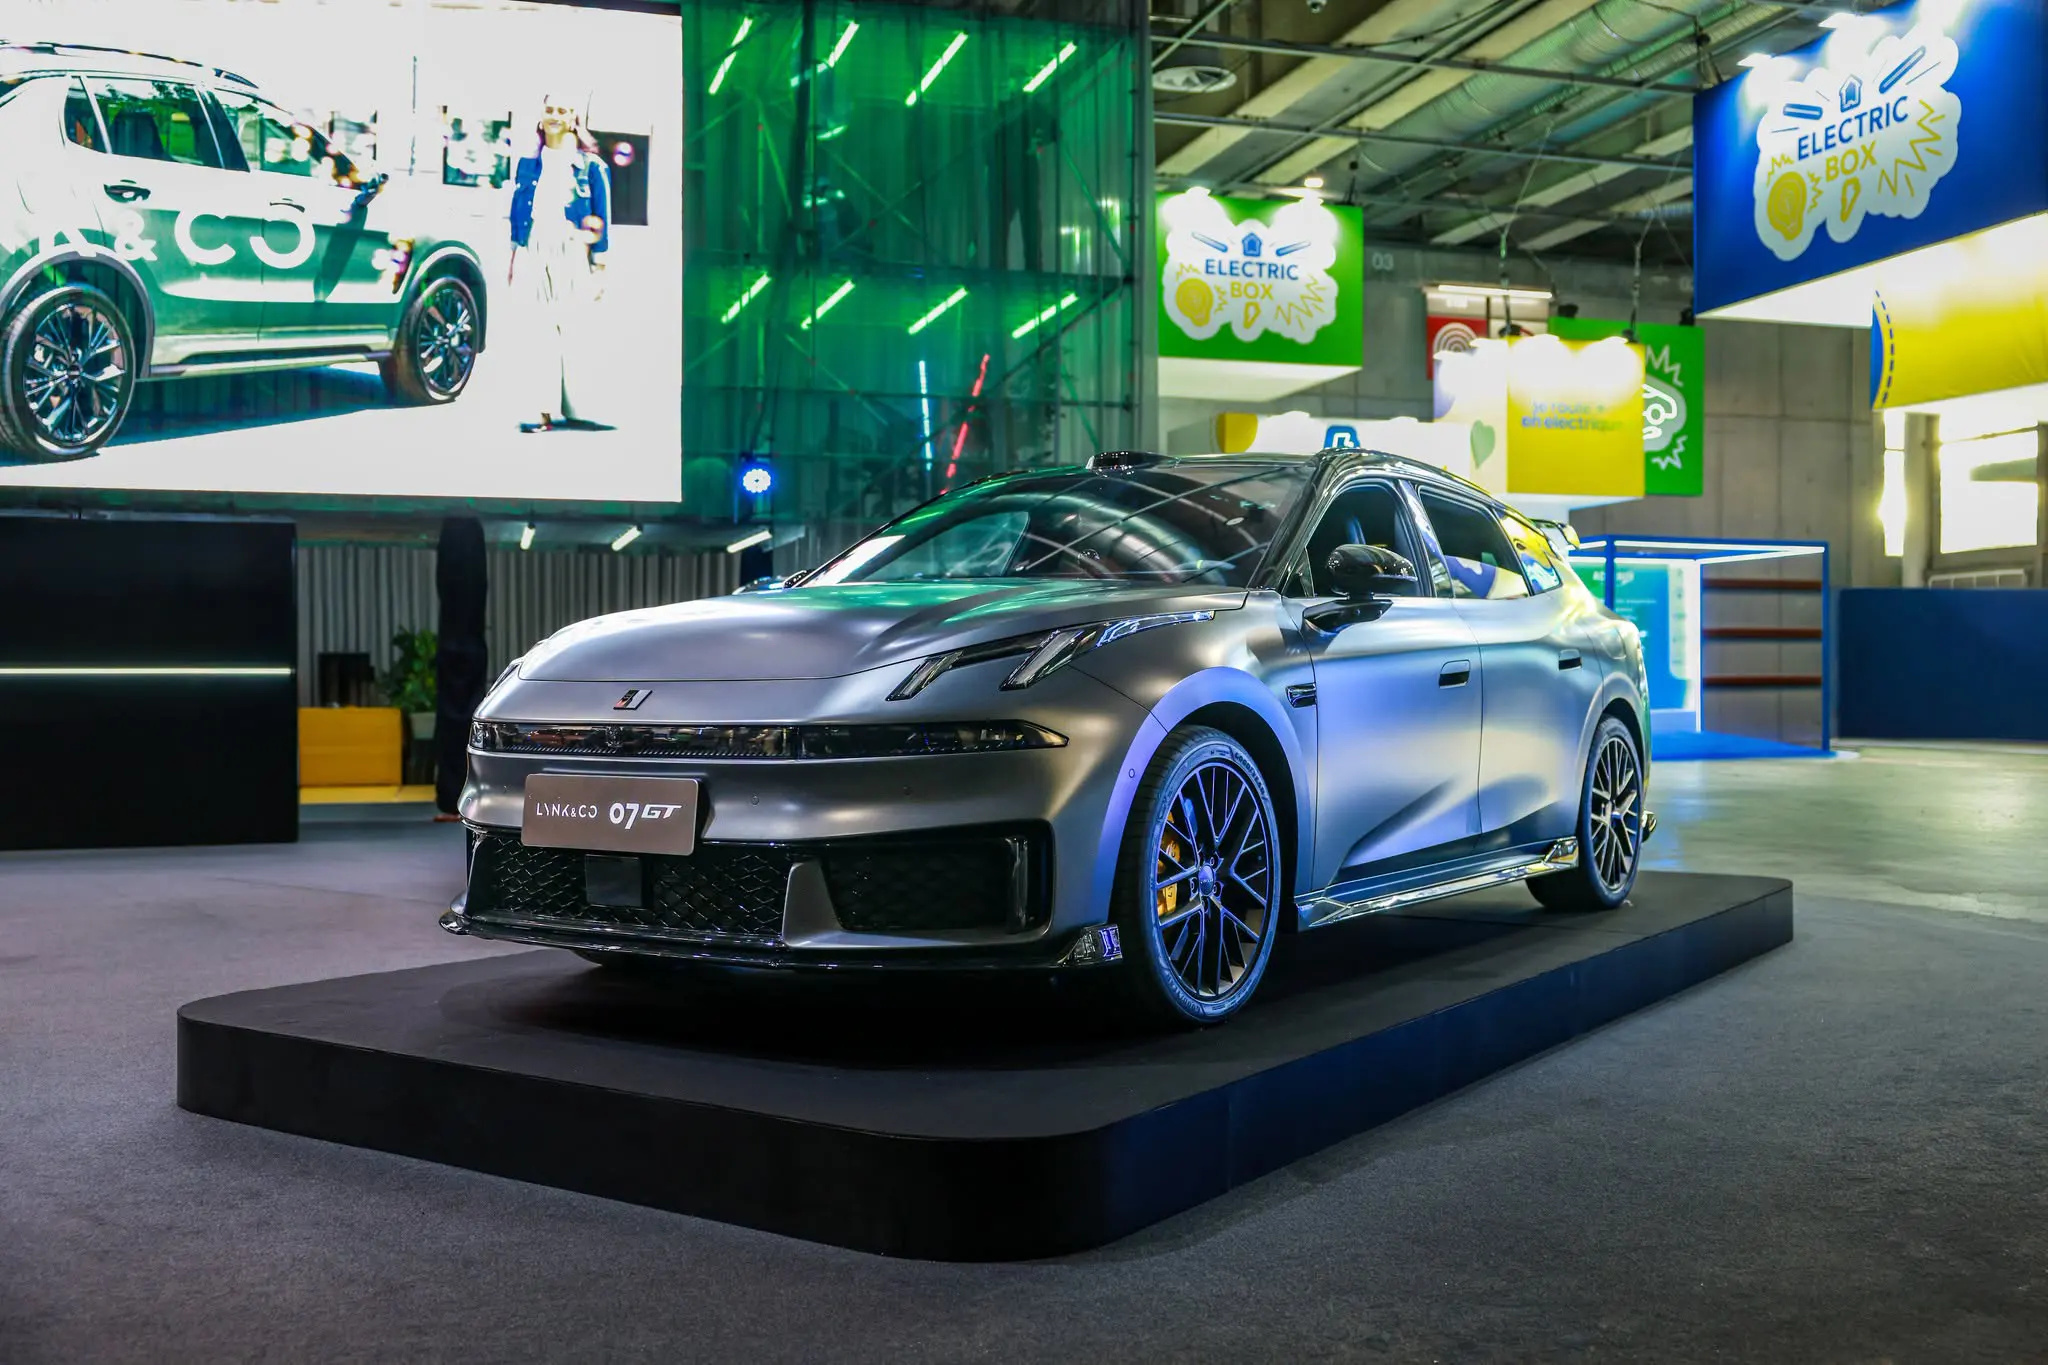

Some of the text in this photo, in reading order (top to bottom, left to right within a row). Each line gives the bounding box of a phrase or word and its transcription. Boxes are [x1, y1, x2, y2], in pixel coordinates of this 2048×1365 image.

[1798, 96, 1909, 161] ELECTRIC
[1825, 140, 1878, 182] BOX
[1205, 258, 1299, 281] ELECTRIC
[1371, 252, 1395, 270] 03
[1229, 281, 1274, 301] BOX
[536, 802, 598, 819] LYNK&CO
